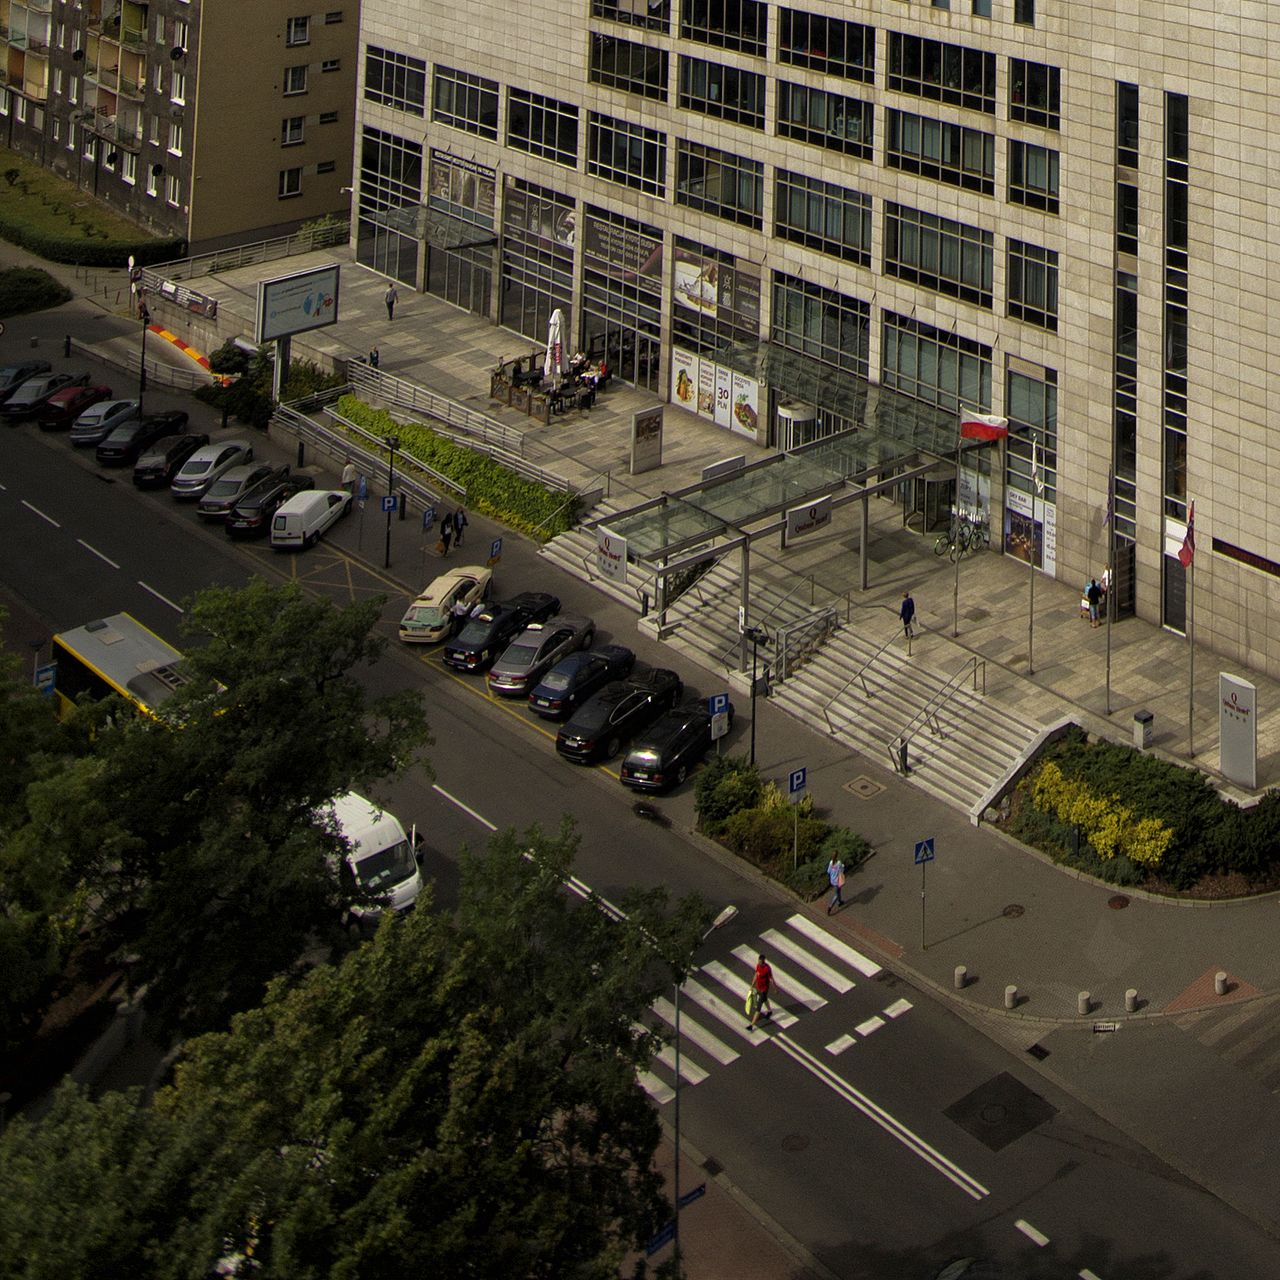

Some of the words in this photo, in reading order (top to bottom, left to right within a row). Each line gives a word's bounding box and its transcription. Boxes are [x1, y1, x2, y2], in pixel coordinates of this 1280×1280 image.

[717, 387, 729, 400] 30
[717, 400, 727, 410] PLN
[384, 497, 394, 509] P
[425, 510, 433, 524] P
[493, 540, 500, 555] P
[715, 696, 725, 712] P
[793, 772, 803, 790] P
